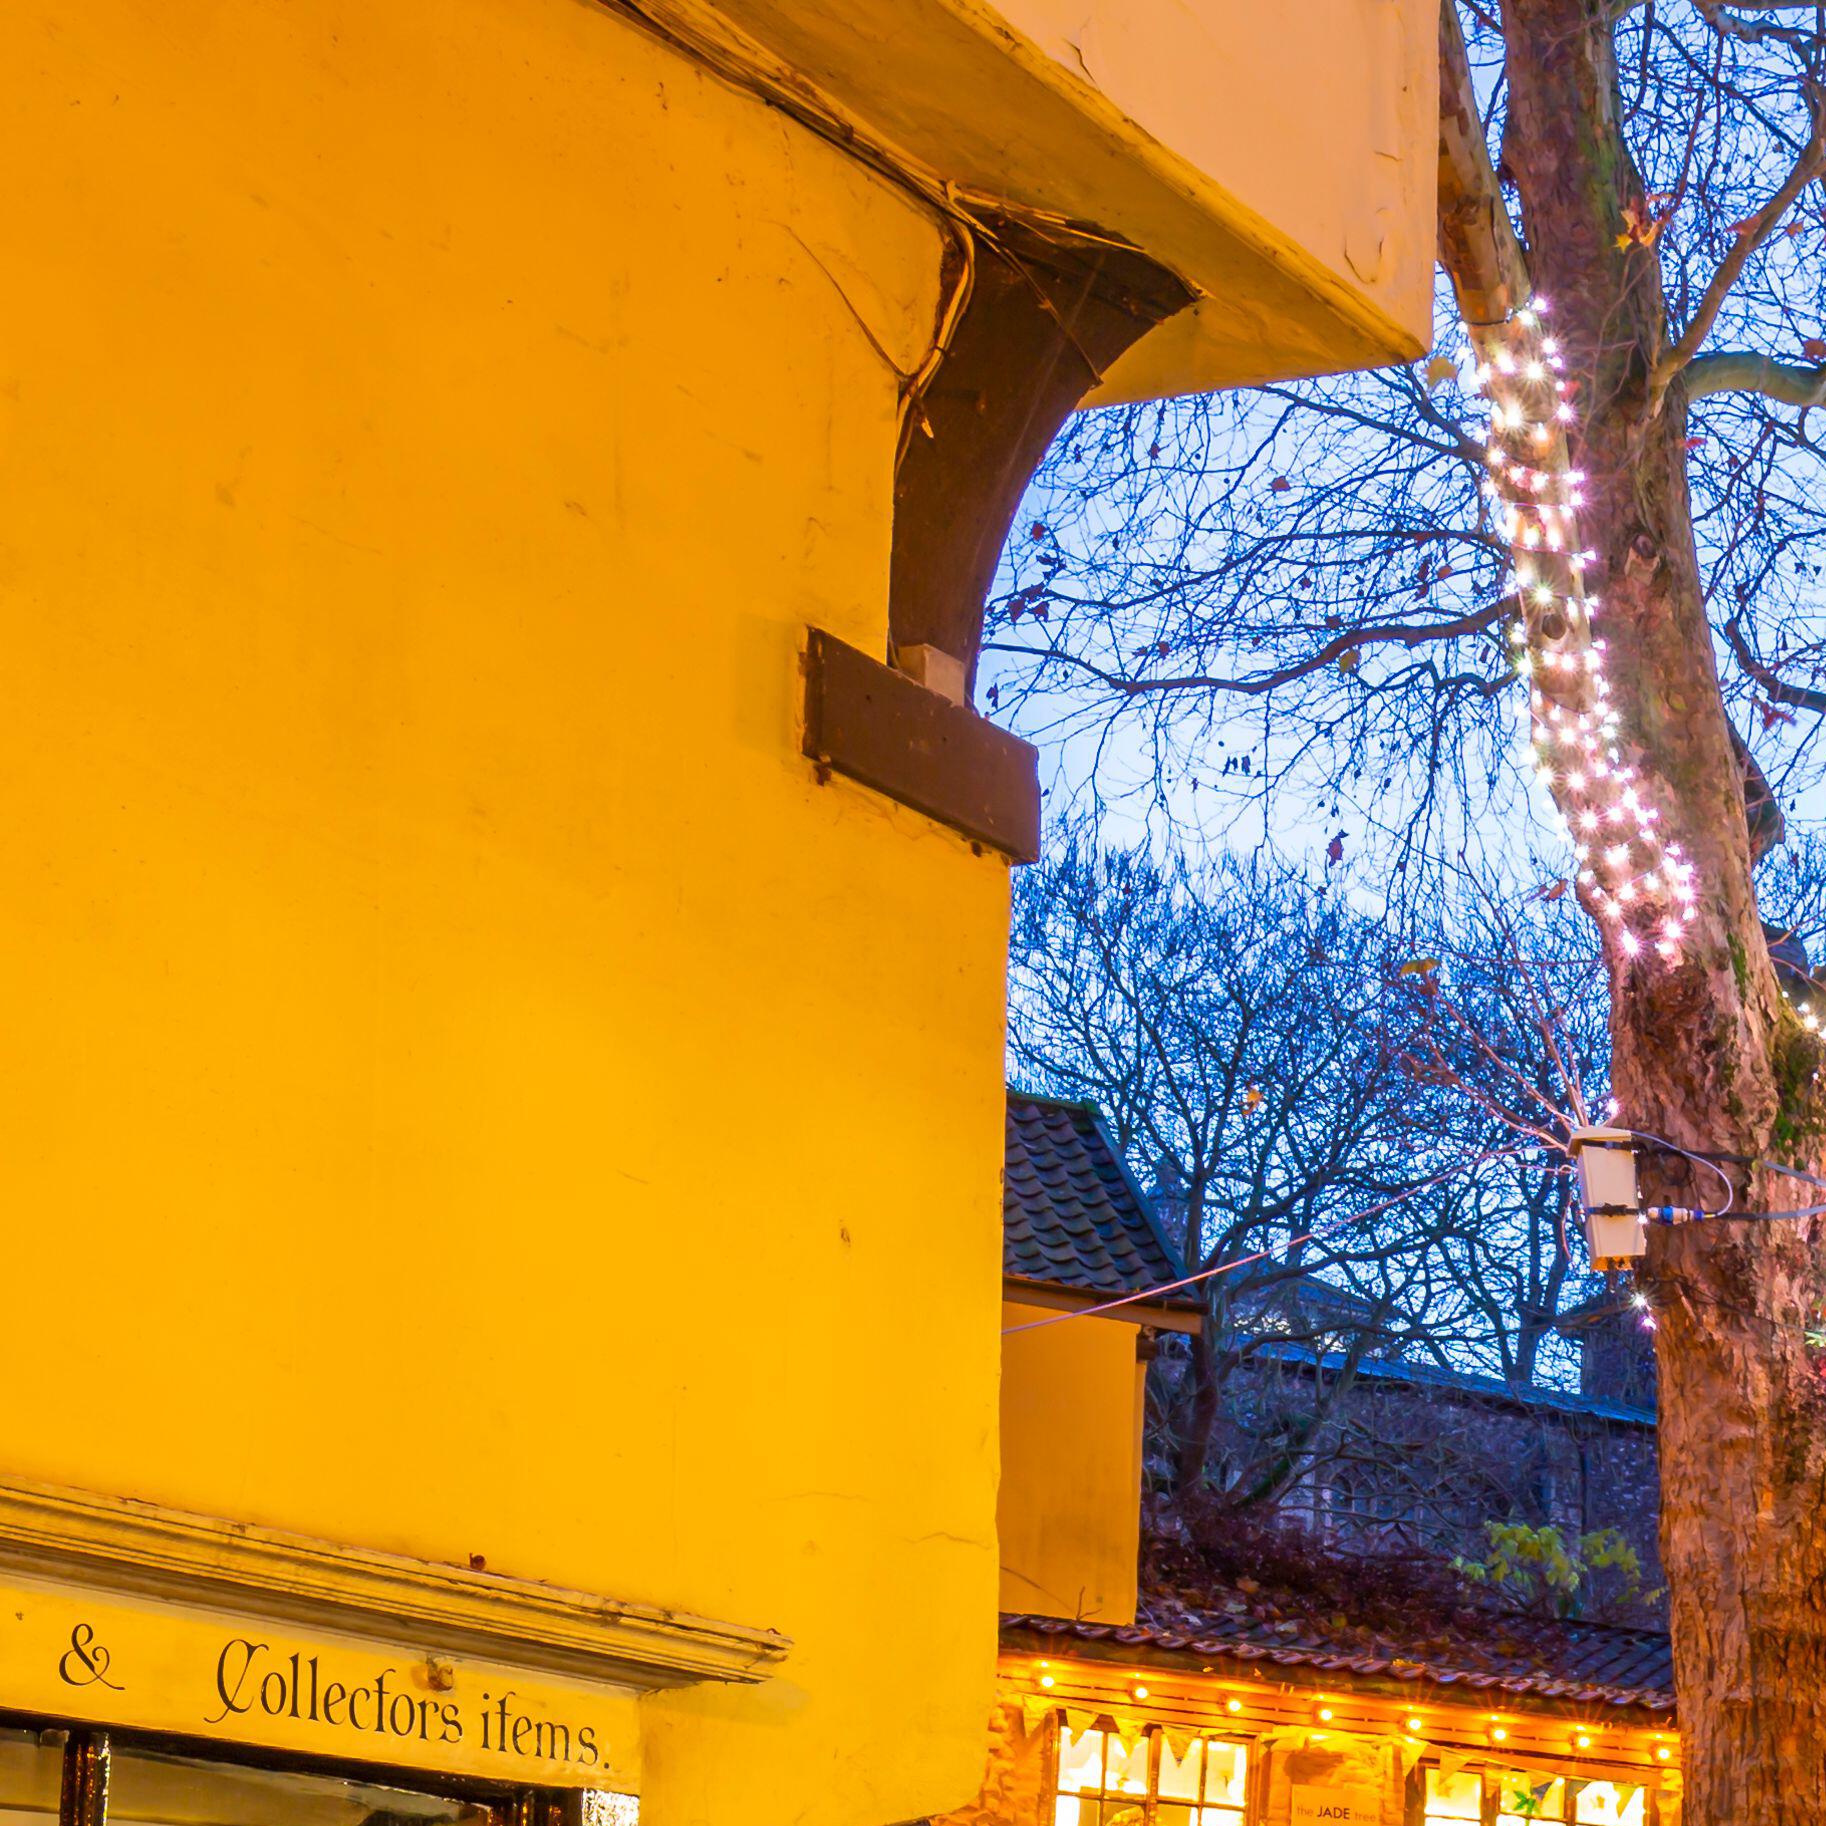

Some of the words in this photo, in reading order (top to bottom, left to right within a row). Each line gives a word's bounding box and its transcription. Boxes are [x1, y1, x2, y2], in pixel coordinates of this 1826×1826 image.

[59, 1623, 125, 1691] &
[204, 1639, 464, 1743] Collectors
[1317, 1805, 1350, 1820] JADE
